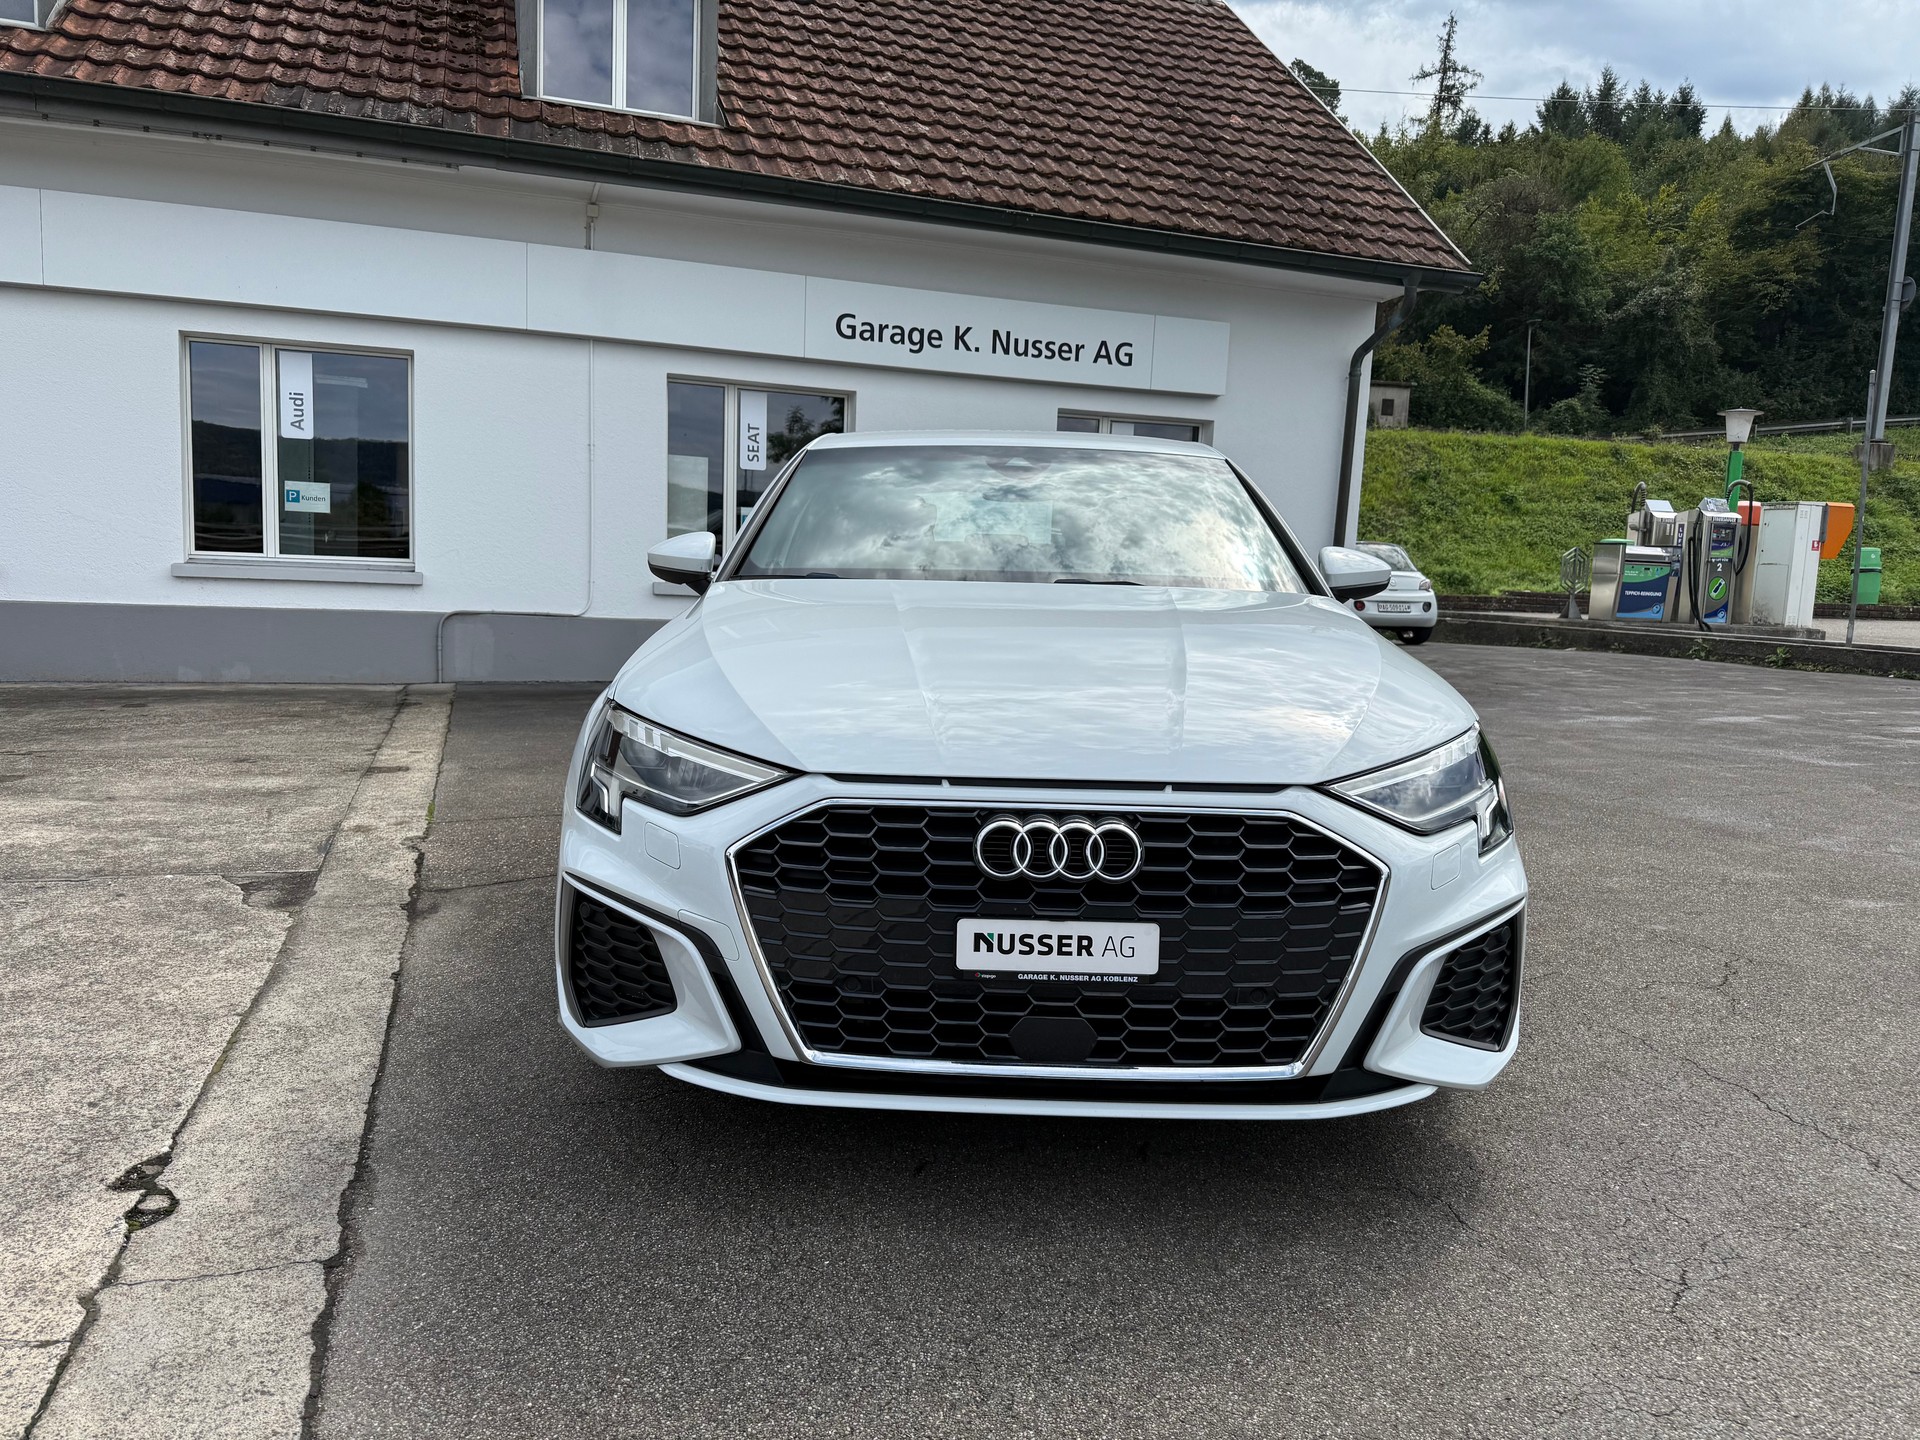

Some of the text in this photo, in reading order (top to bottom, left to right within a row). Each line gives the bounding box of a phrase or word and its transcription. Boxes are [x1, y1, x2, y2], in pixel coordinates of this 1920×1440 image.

[835, 312, 1134, 367] Garage K. Nusser AG
[288, 392, 305, 431] Audi
[747, 423, 760, 462] SEAT
[301, 494, 326, 502] Kunden
[1717, 562, 1723, 572] 2
[973, 932, 1135, 958] NUSSER AG
[1059, 974, 1090, 982] NUSSER
[1103, 975, 1139, 983] KOBLENZ
